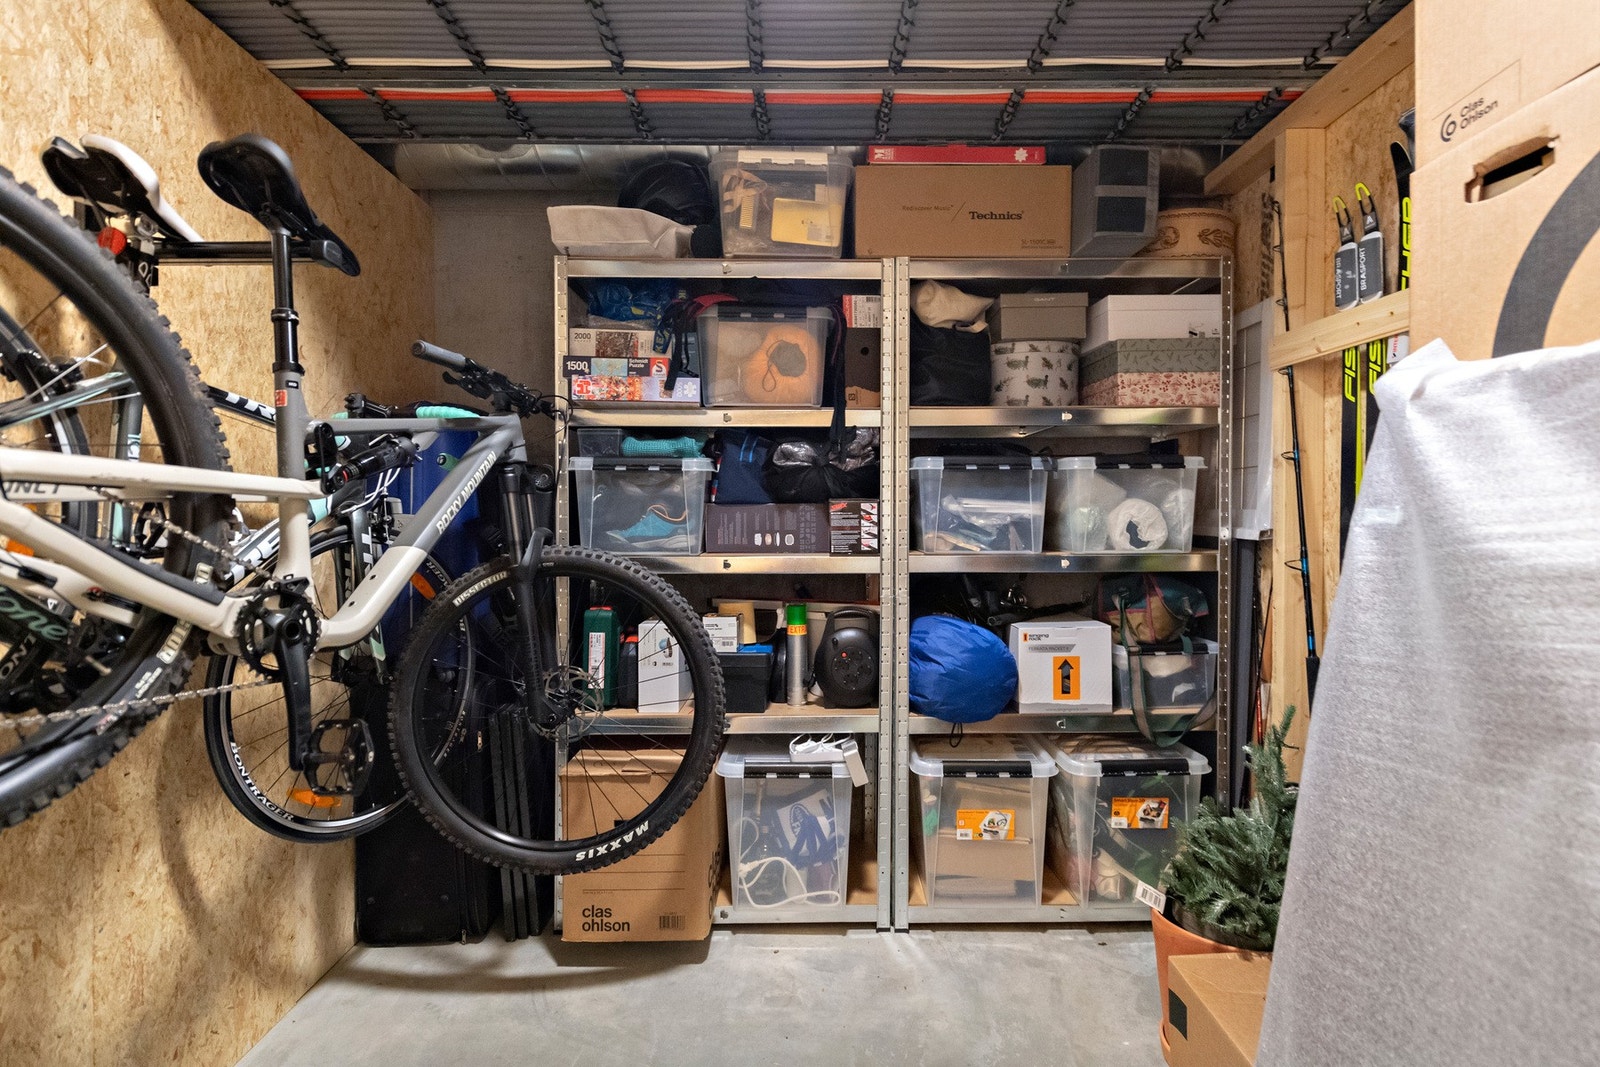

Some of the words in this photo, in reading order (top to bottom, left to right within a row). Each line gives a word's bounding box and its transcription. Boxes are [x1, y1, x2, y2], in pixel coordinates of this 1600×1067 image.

[1460, 97, 1485, 118] Clas
[1460, 100, 1499, 129] Ohlson
[969, 210, 1023, 221] Technics
[574, 332, 592, 340] 2000
[566, 361, 588, 371] 1500
[435, 494, 463, 536] ROCKY
[460, 450, 498, 502] MOUNTAIN
[452, 570, 508, 607] DISSECTOR
[230, 741, 295, 821] BONTRAGER
[575, 819, 650, 862] MAXXIS
[582, 905, 613, 919] clas
[582, 918, 631, 932] ohlson
